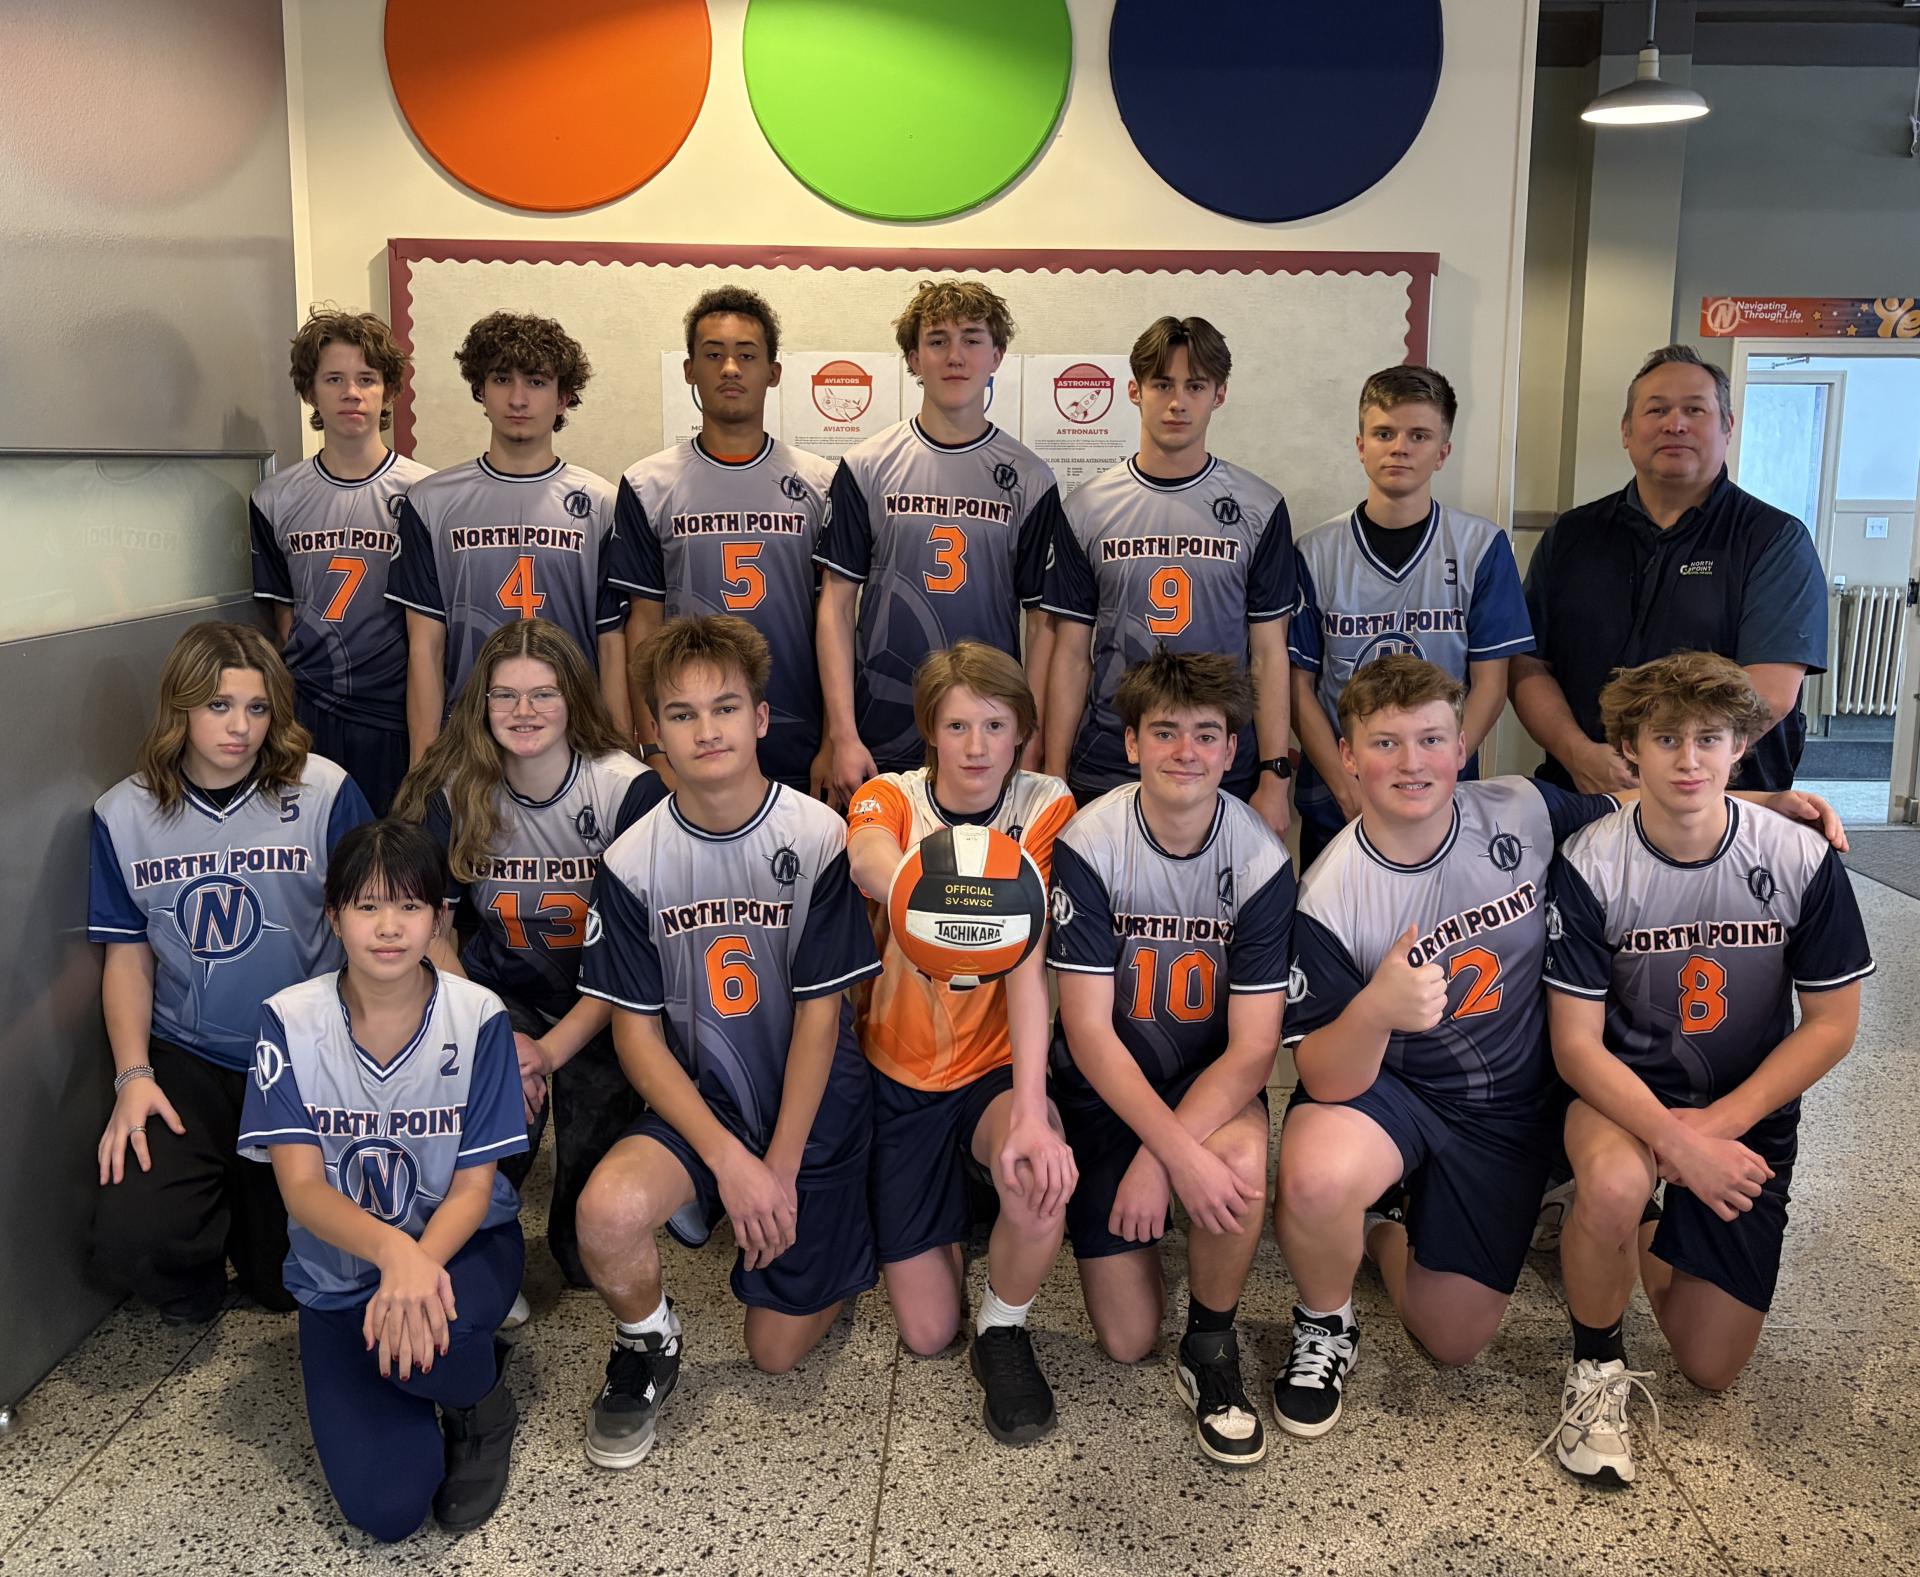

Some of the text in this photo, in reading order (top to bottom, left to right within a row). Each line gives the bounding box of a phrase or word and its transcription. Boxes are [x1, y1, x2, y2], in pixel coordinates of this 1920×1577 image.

[1737, 301, 1787, 312] Navigating
[1744, 310, 1802, 321] Through Life
[671, 512, 806, 537] NORTH POINT
[884, 492, 1013, 526] NORTH POINT
[349, 528, 395, 552] POIN
[450, 525, 585, 553] NORTH POINT
[1100, 535, 1241, 563] NORTH POINT
[922, 523, 968, 594] 3
[1443, 558, 1458, 586] 3
[321, 554, 368, 621] 7
[496, 555, 546, 620] 4
[720, 541, 767, 611] 5
[1145, 565, 1193, 637] 9
[1323, 608, 1466, 637] NORTH POINT
[280, 793, 301, 824] 5
[131, 845, 312, 889] NORTH POINT
[543, 857, 599, 882] POIN
[945, 884, 994, 897] OFFICIAL
[945, 897, 993, 908] SV-5WSC
[192, 886, 245, 951] N
[488, 891, 589, 949] 13
[935, 921, 1004, 942] TACHIKARA
[1407, 915, 1466, 968] ORTH
[1460, 879, 1537, 938] POINT
[1706, 919, 1784, 948] POINT
[704, 935, 761, 1019] 6
[1129, 946, 1217, 1023] 10
[1447, 945, 1504, 1022] 2
[1678, 954, 1728, 1035] 8
[440, 1043, 460, 1077] 2
[358, 1150, 403, 1216] N
